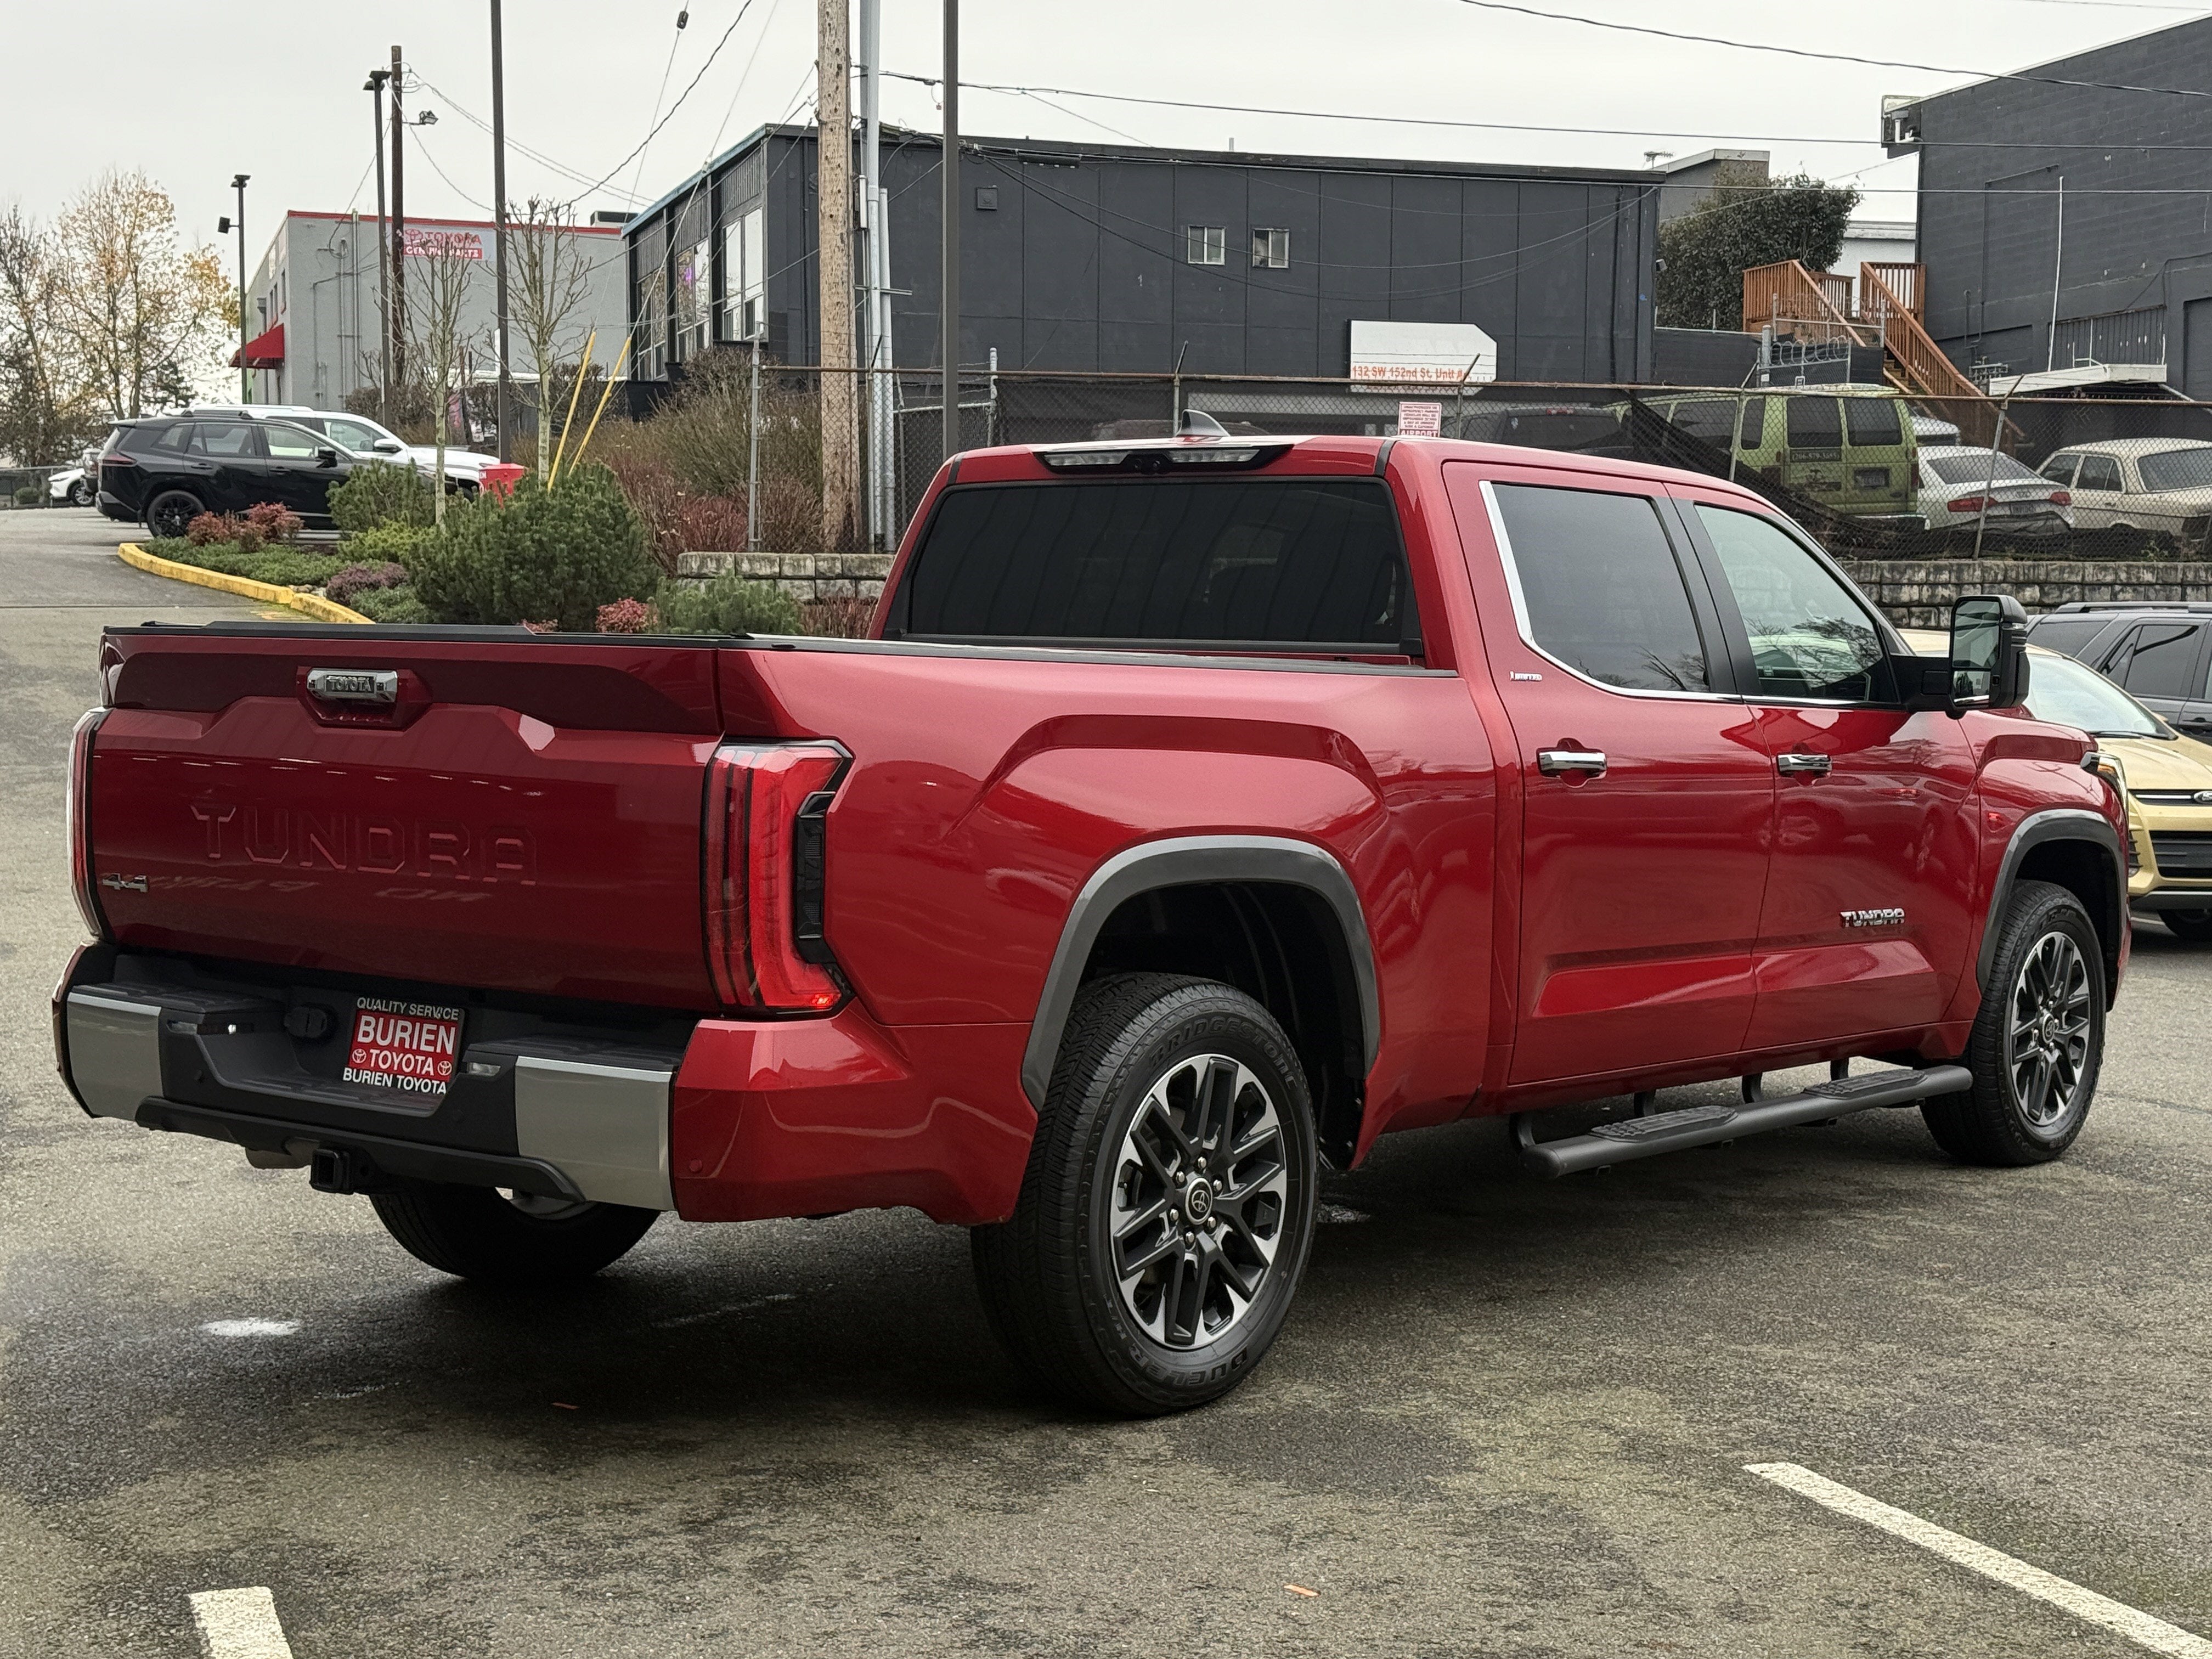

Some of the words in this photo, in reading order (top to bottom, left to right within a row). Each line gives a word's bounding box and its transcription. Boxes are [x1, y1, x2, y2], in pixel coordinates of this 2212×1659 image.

[425, 232, 482, 245] TOYOTA
[1352, 365, 1369, 377] 132
[1372, 366, 1387, 377] SW
[1390, 366, 1417, 378] 152nd
[326, 675, 372, 691] TOYOTA
[190, 802, 538, 885] TUNDRA
[1840, 908, 1905, 928] TUNDRA
[357, 997, 408, 1014] QUALITY
[409, 1003, 460, 1021] SERVICE
[357, 1014, 456, 1055] BURIEN
[369, 1048, 435, 1076] TOYOTA
[1149, 1015, 1297, 1090] BRIDGESTONE
[342, 1067, 393, 1088] BURIEN
[397, 1075, 447, 1095] TOYOTA
